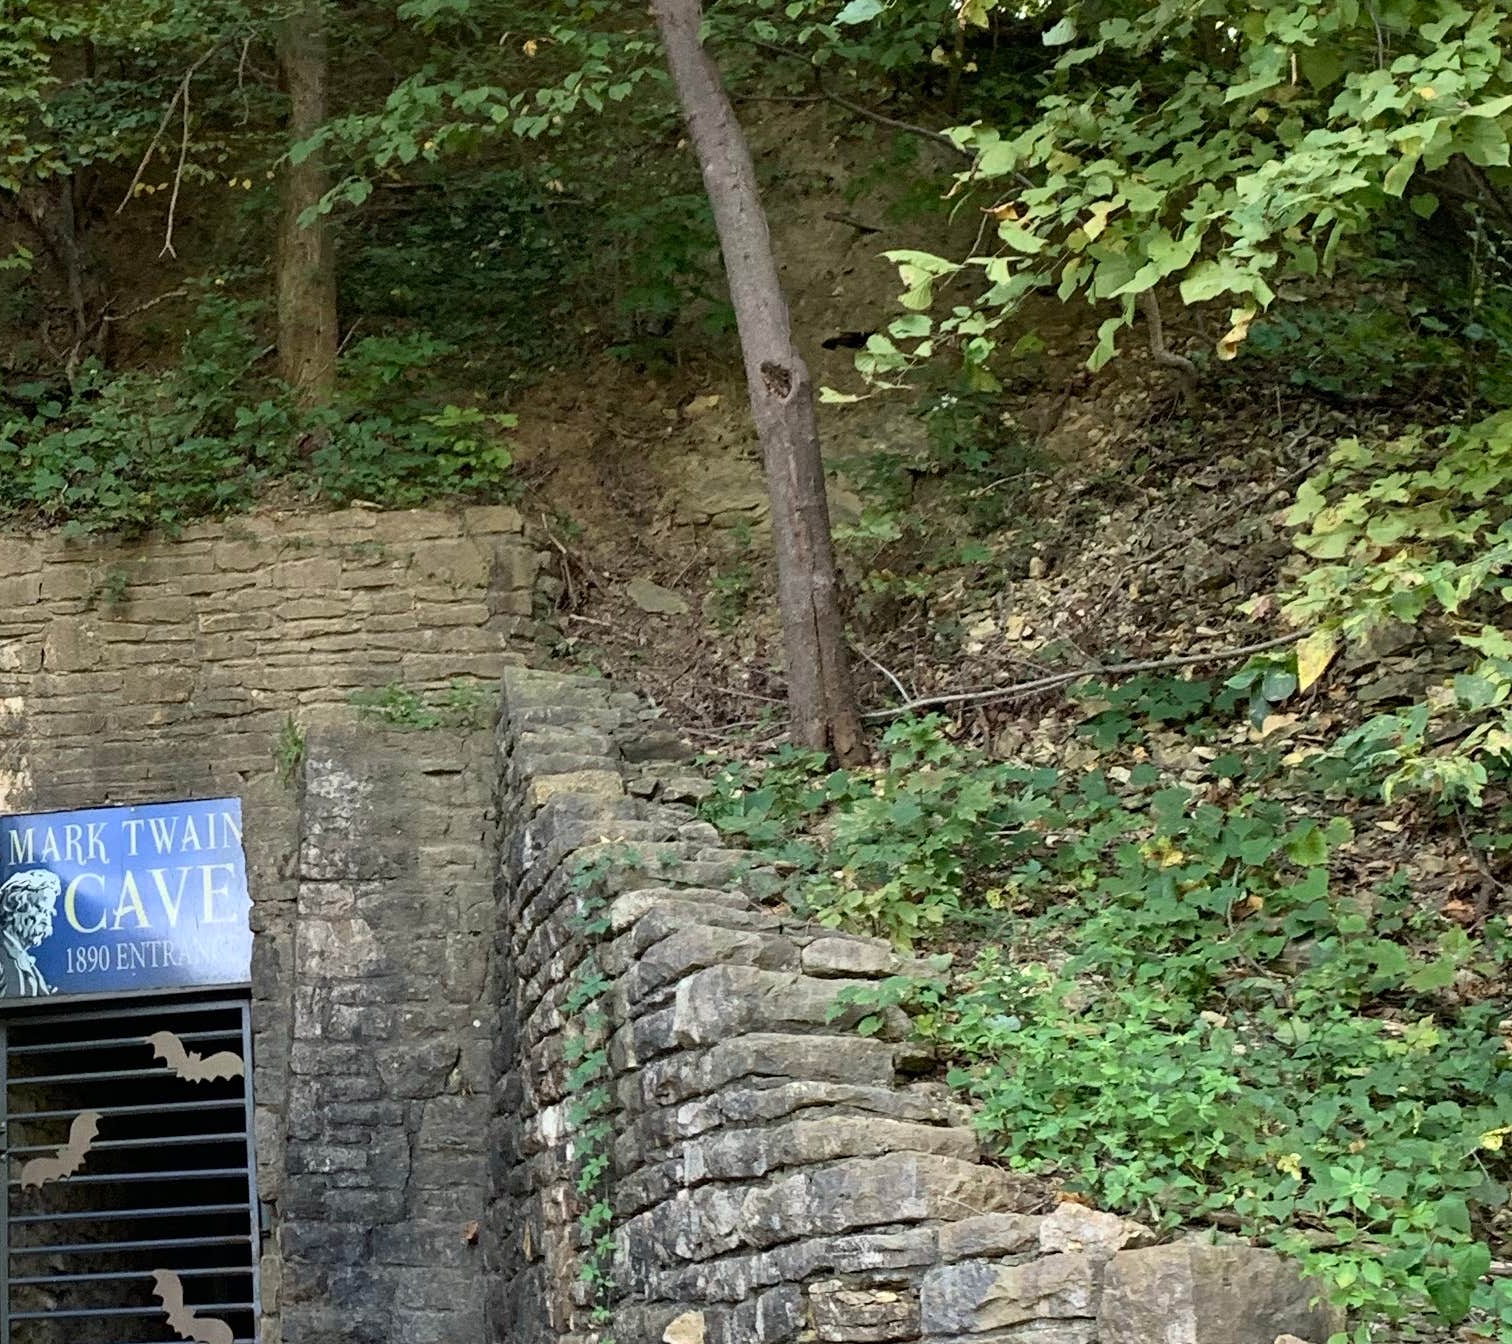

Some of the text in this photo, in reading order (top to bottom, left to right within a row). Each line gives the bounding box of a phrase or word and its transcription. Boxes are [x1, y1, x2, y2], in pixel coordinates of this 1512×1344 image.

[8, 811, 243, 866] MARK TWAIN
[63, 862, 239, 934] CAVE
[65, 934, 236, 974] 1890 ENTRANC
